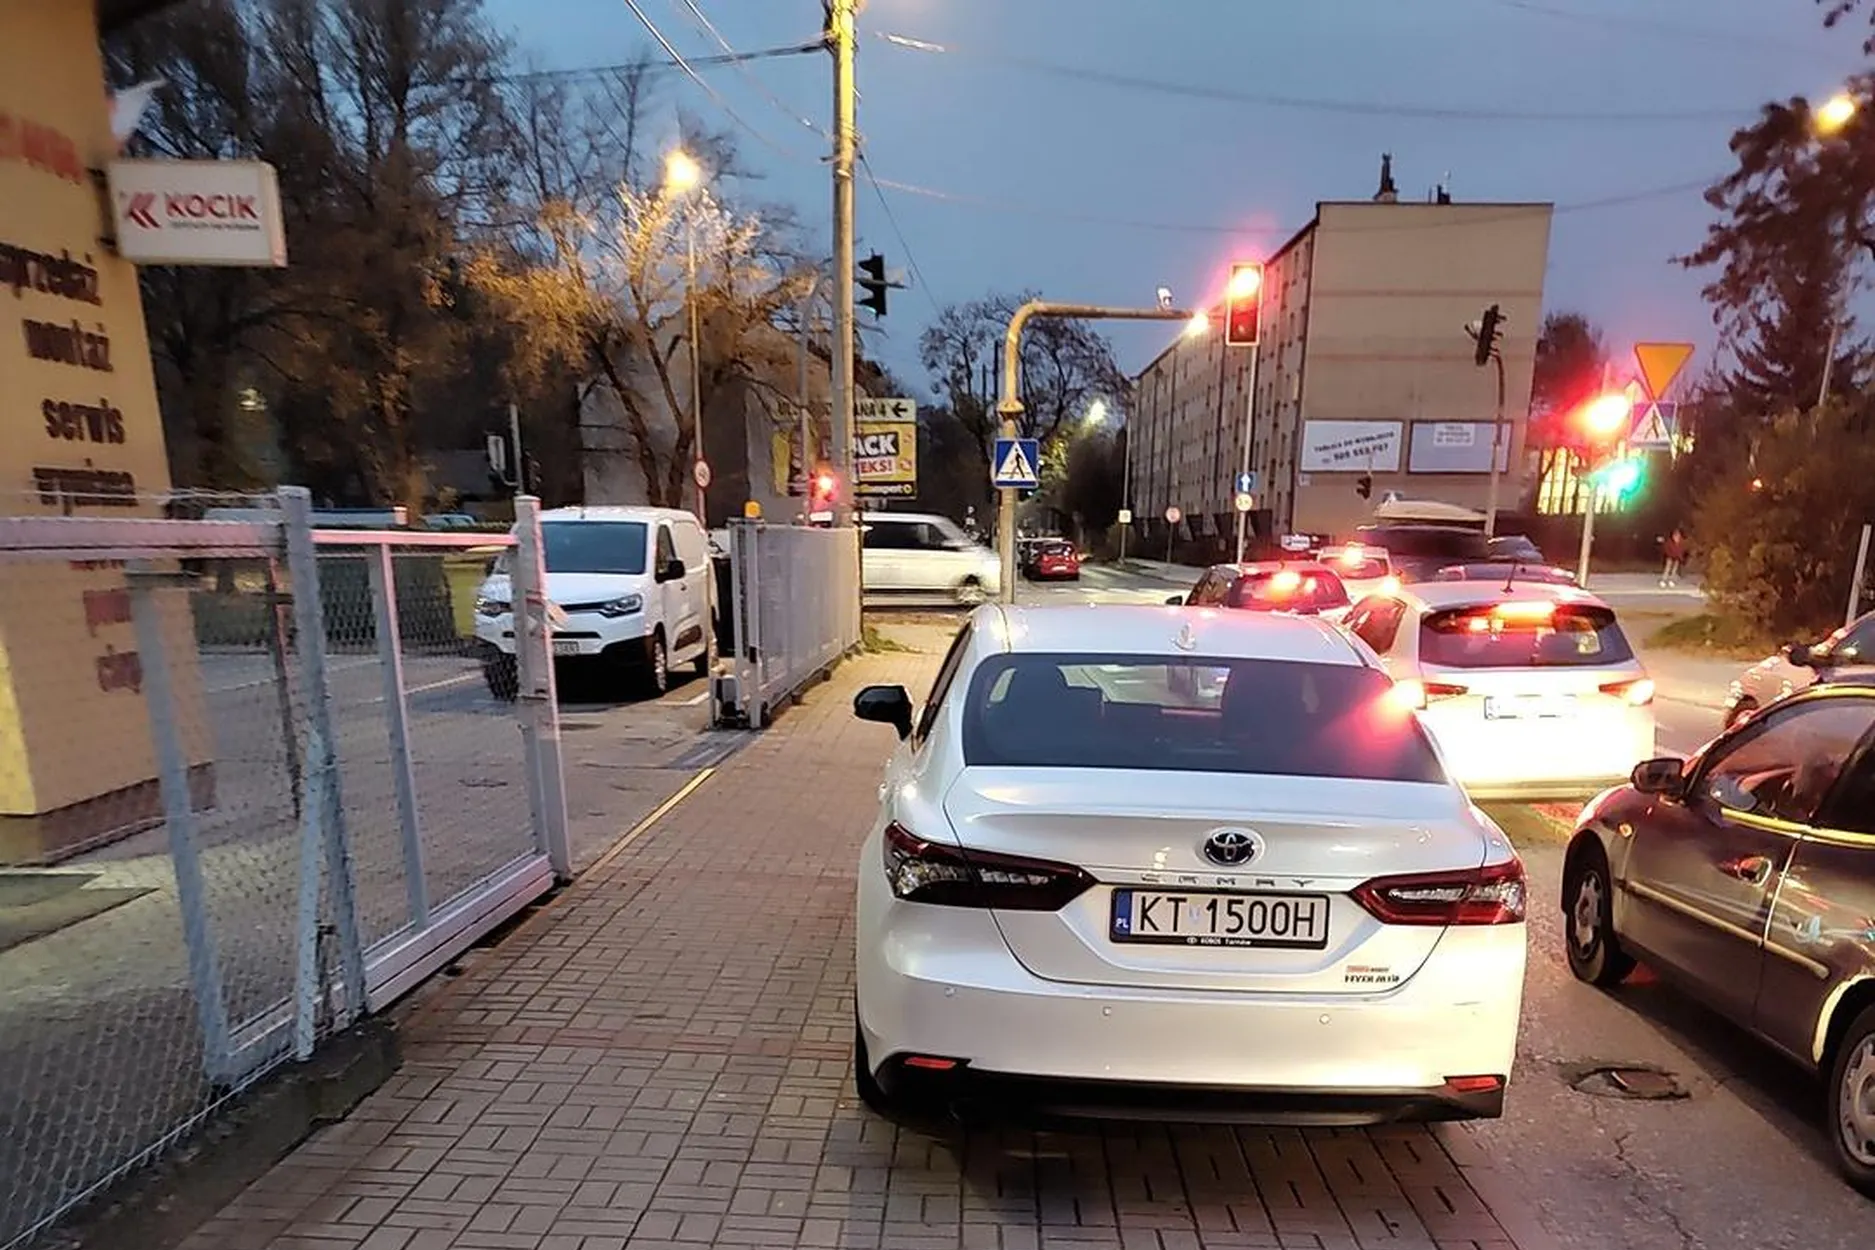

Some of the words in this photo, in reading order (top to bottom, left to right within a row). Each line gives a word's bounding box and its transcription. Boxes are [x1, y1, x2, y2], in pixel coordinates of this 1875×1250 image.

[164, 192, 258, 219] KOCIK
[22, 319, 114, 372] montaż
[41, 398, 126, 444] serwis
[853, 434, 897, 458] ACK
[1115, 917, 1129, 929] PL
[1140, 896, 1188, 932] KT
[1206, 898, 1315, 937] 1500H
